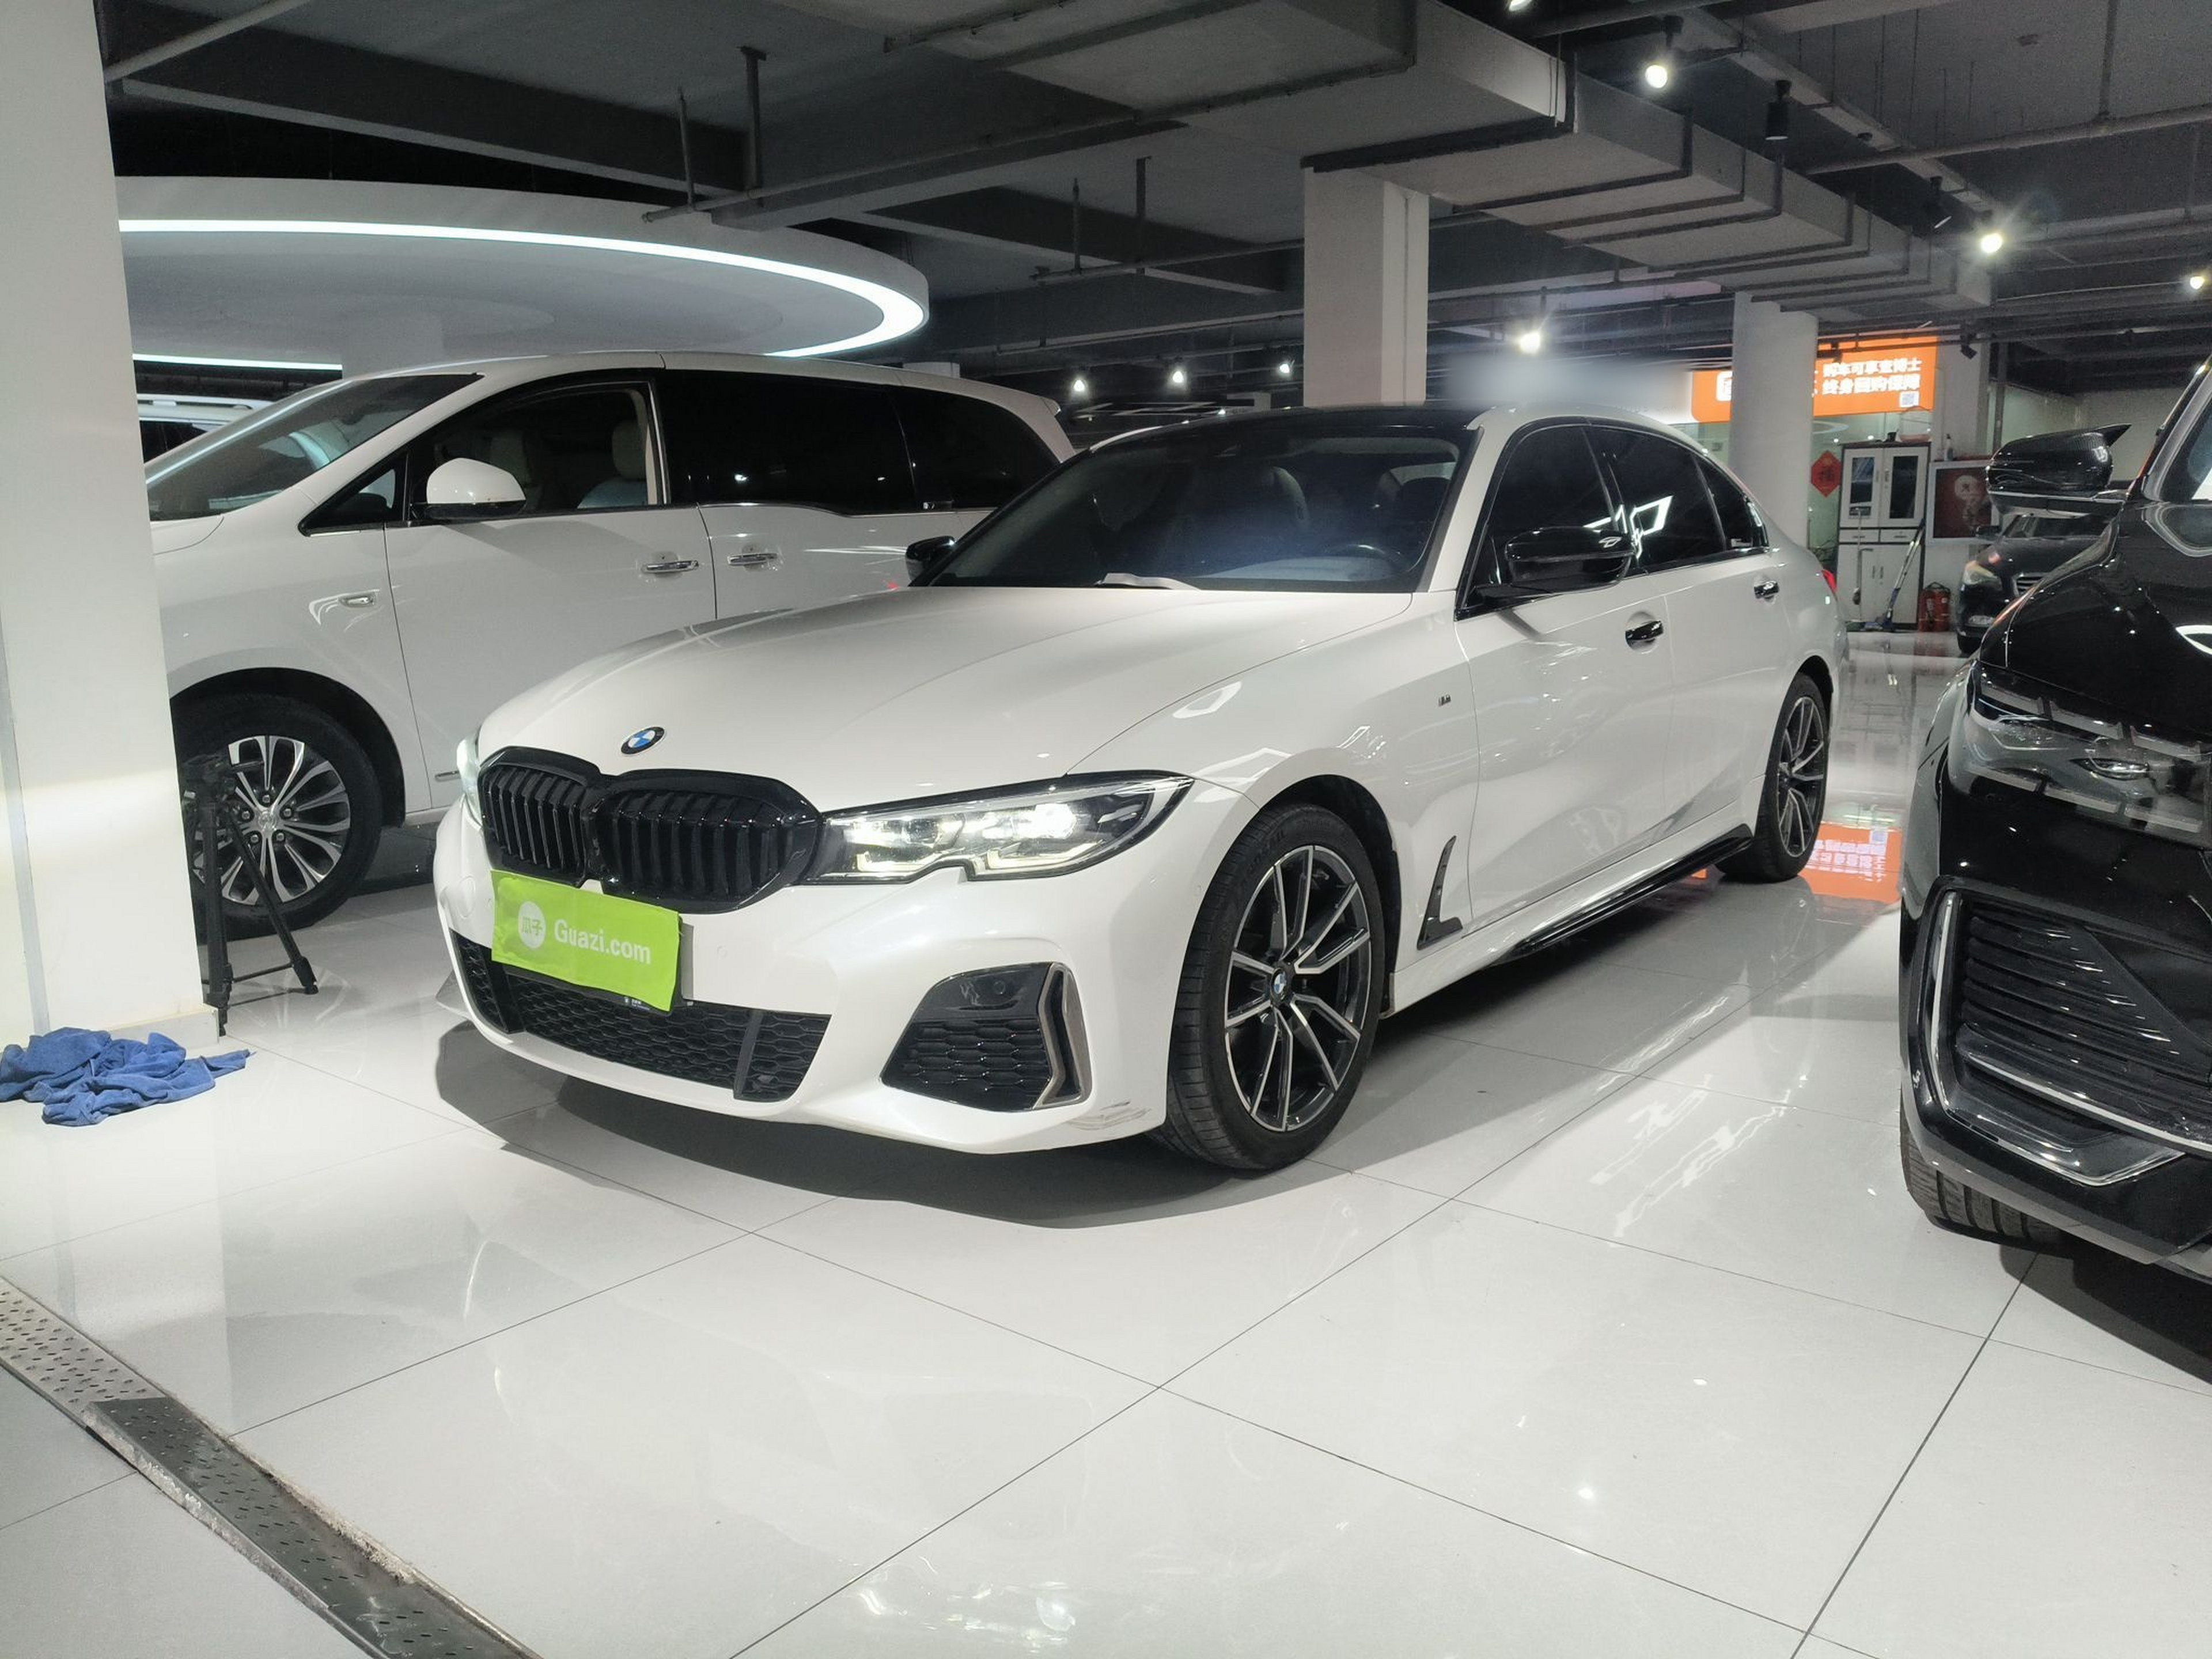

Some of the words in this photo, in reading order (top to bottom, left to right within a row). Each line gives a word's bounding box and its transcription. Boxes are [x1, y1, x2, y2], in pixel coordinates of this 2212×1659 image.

[1823, 373, 1921, 395] 终身回购保障
[521, 915, 543, 936] 瓜子
[554, 918, 652, 965] Guazi.com
